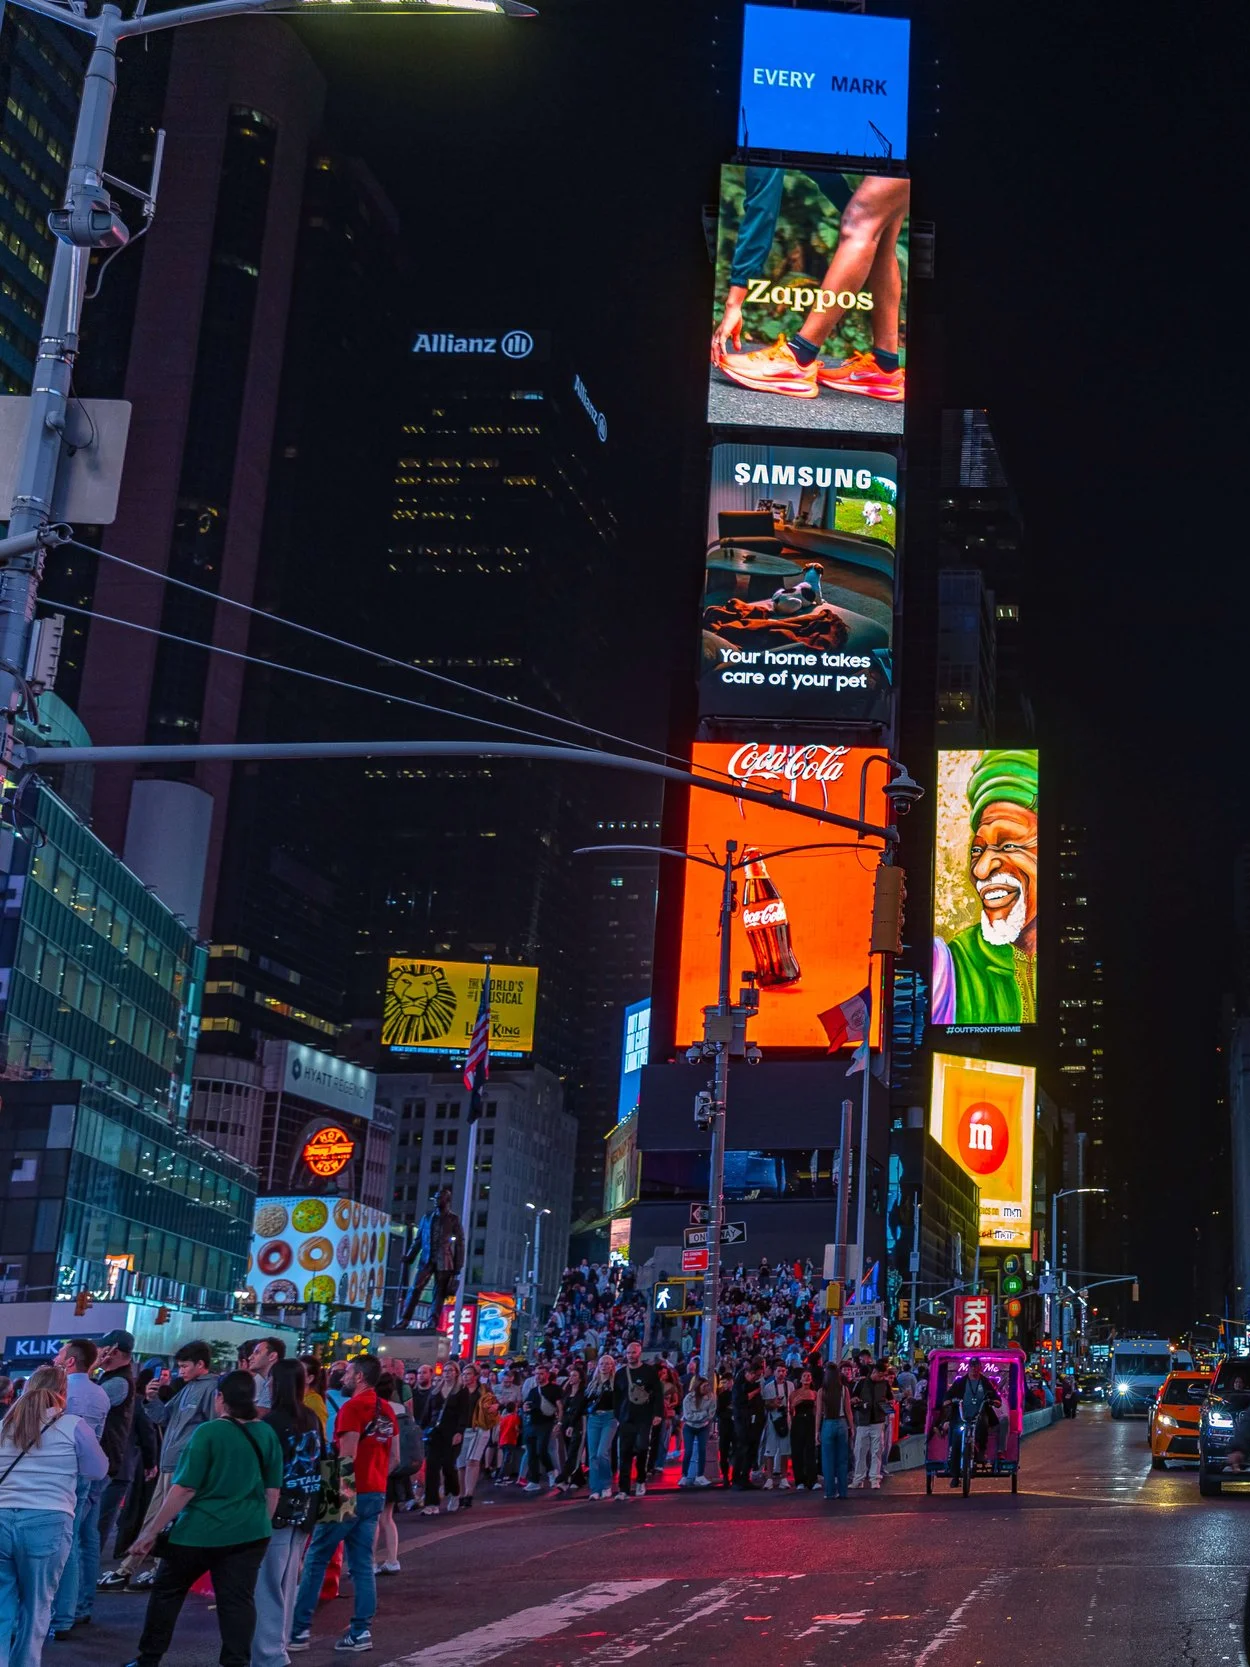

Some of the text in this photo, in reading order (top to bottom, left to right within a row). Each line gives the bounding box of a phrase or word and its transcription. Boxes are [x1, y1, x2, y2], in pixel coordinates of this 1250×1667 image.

[753, 68, 887, 96] EVERY MARK
[747, 278, 874, 312] Zappos
[413, 333, 497, 353] Allianz
[574, 374, 598, 425] Allianz
[734, 463, 872, 489] SAMSUNG
[720, 648, 871, 668] Your home takes
[721, 670, 867, 691] care of your pet
[489, 991, 523, 1005] USICAL
[946, 1026, 1021, 1034] #OUTFRONTPRIME
[304, 1067, 332, 1088] HYATT
[320, 1131, 340, 1142] HOT
[969, 1122, 993, 1151] m
[316, 1160, 340, 1171] NOW
[964, 1298, 986, 1347] tkts
